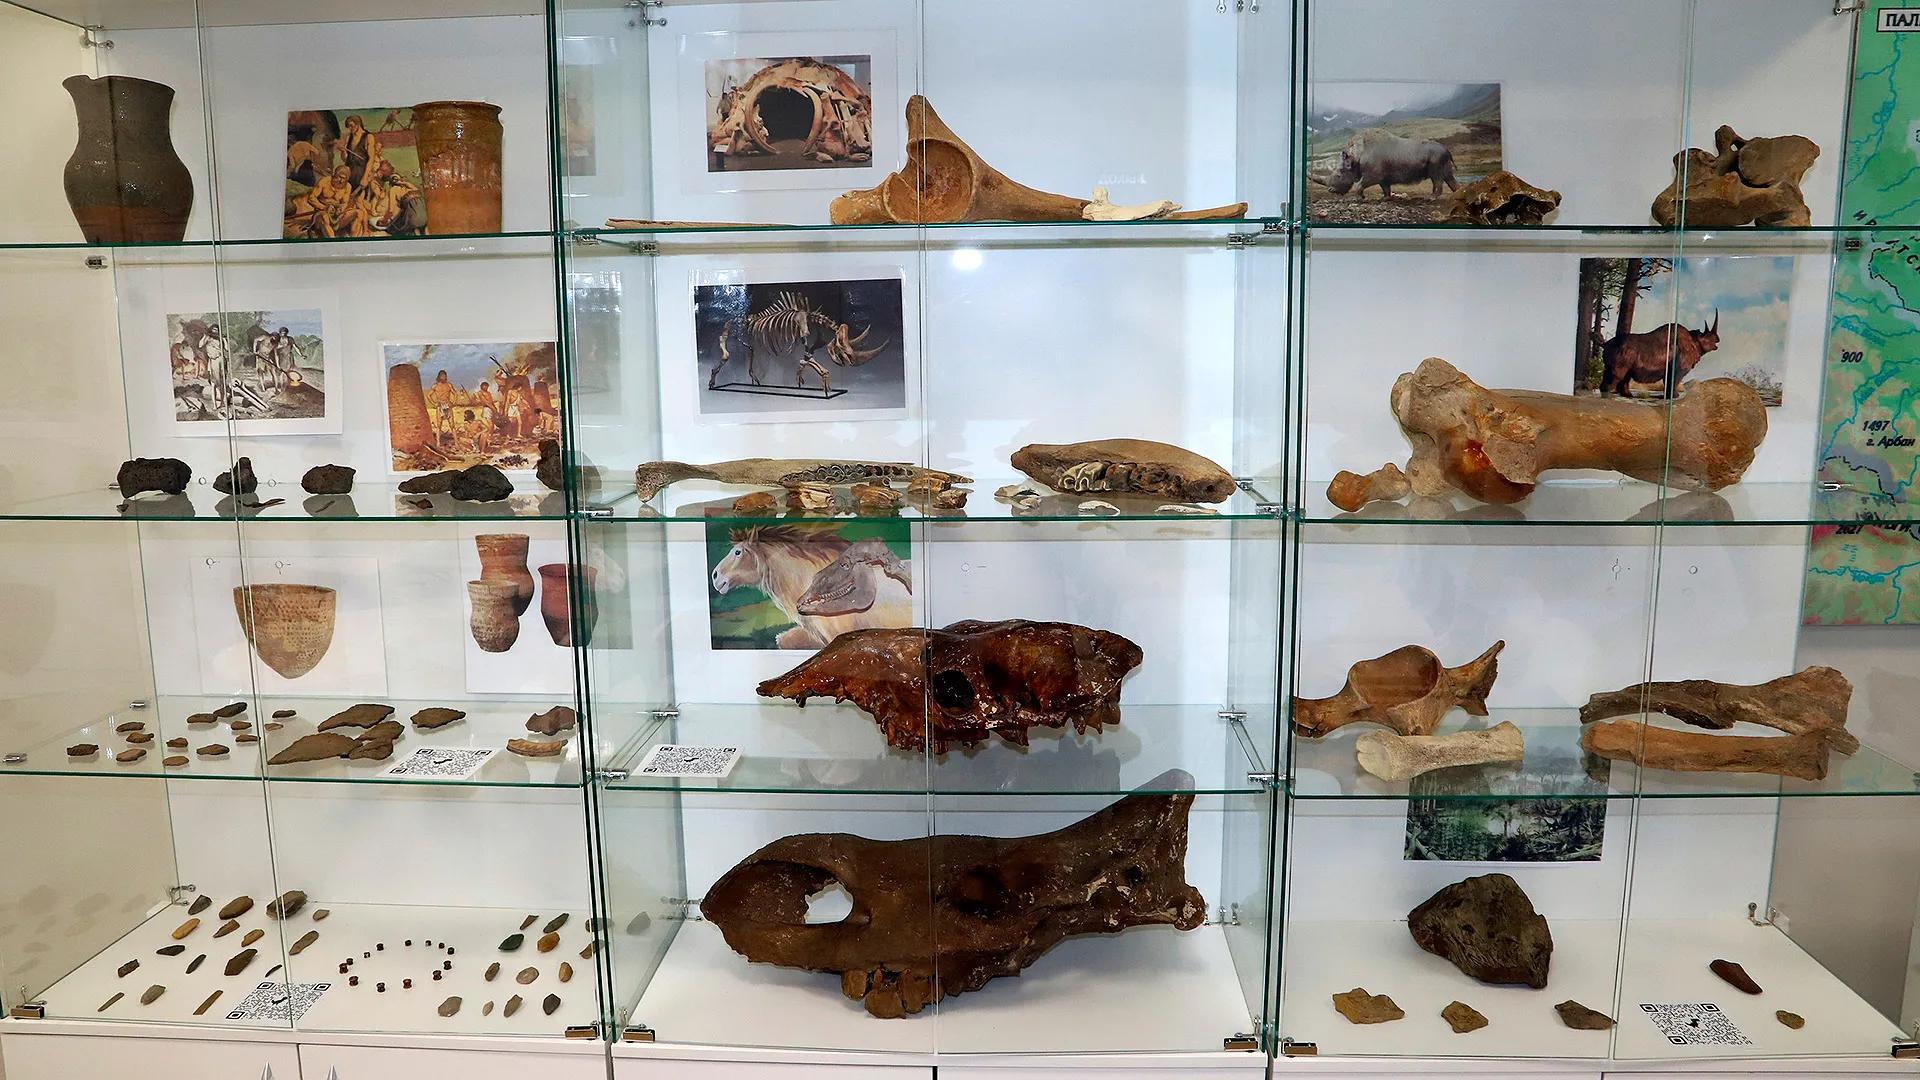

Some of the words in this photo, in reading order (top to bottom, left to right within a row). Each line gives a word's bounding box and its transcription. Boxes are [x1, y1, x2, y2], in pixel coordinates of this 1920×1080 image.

[1886, 13, 1920, 27] ПАЛ
[1841, 351, 1863, 363] 900
[1862, 420, 1890, 432] 1497
[1877, 434, 1915, 449] Арбан
